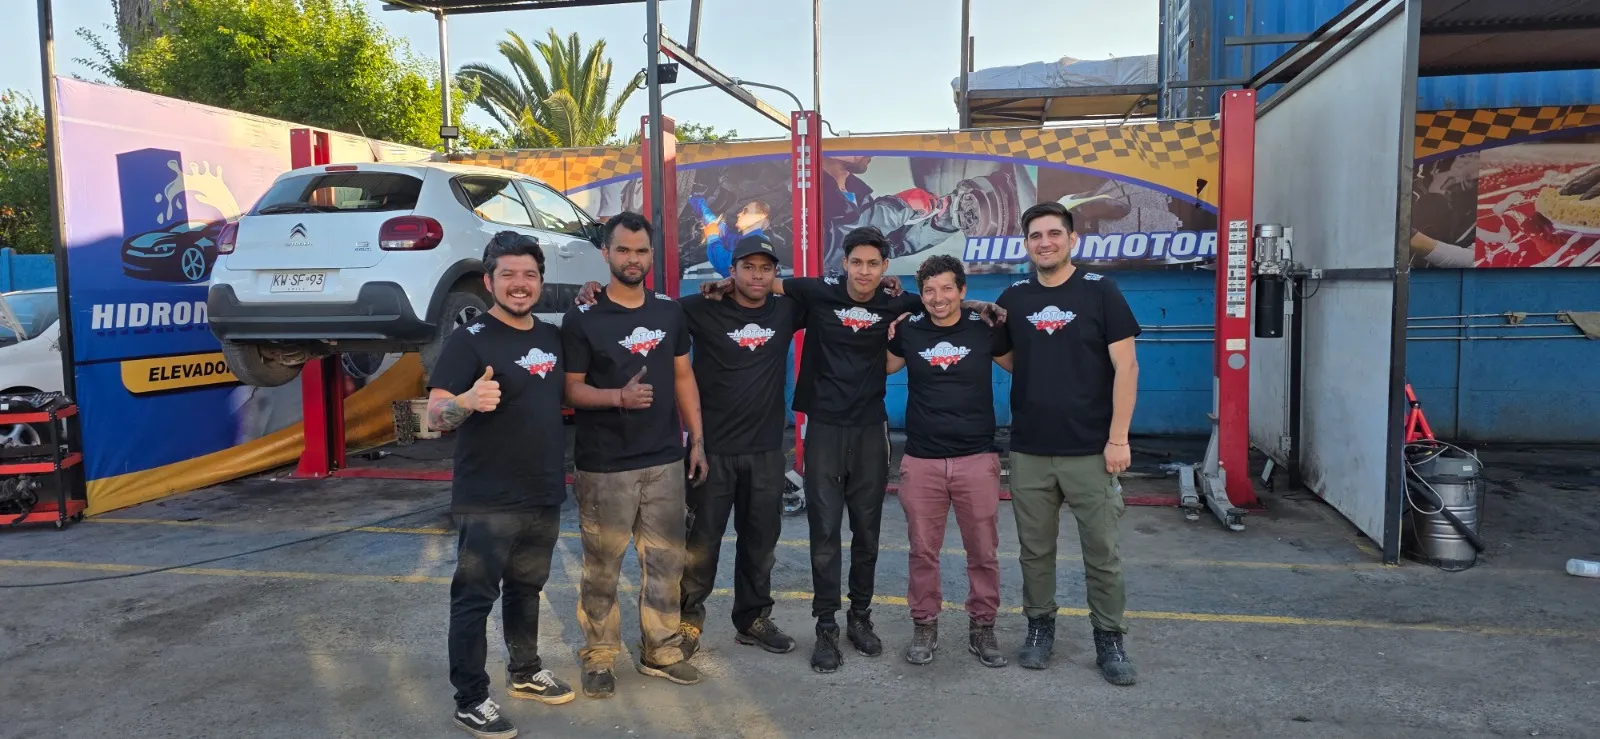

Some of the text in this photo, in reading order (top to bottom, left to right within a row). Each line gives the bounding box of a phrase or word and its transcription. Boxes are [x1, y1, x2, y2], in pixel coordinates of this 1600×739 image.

[964, 231, 1217, 260] HIDMOTOR
[839, 308, 879, 321] MOTOR
[1031, 310, 1073, 321] MOTOR
[842, 317, 873, 329] SPOT
[1036, 320, 1066, 331] SPOT
[625, 329, 662, 346] MOTOR
[733, 327, 772, 338] MOTOR
[631, 339, 660, 354] SPOT
[738, 337, 768, 347] SPOT
[924, 346, 967, 357] MOTOR
[520, 352, 556, 366] MOTOR
[930, 355, 960, 366] SPOT
[529, 361, 554, 375] SPOT
